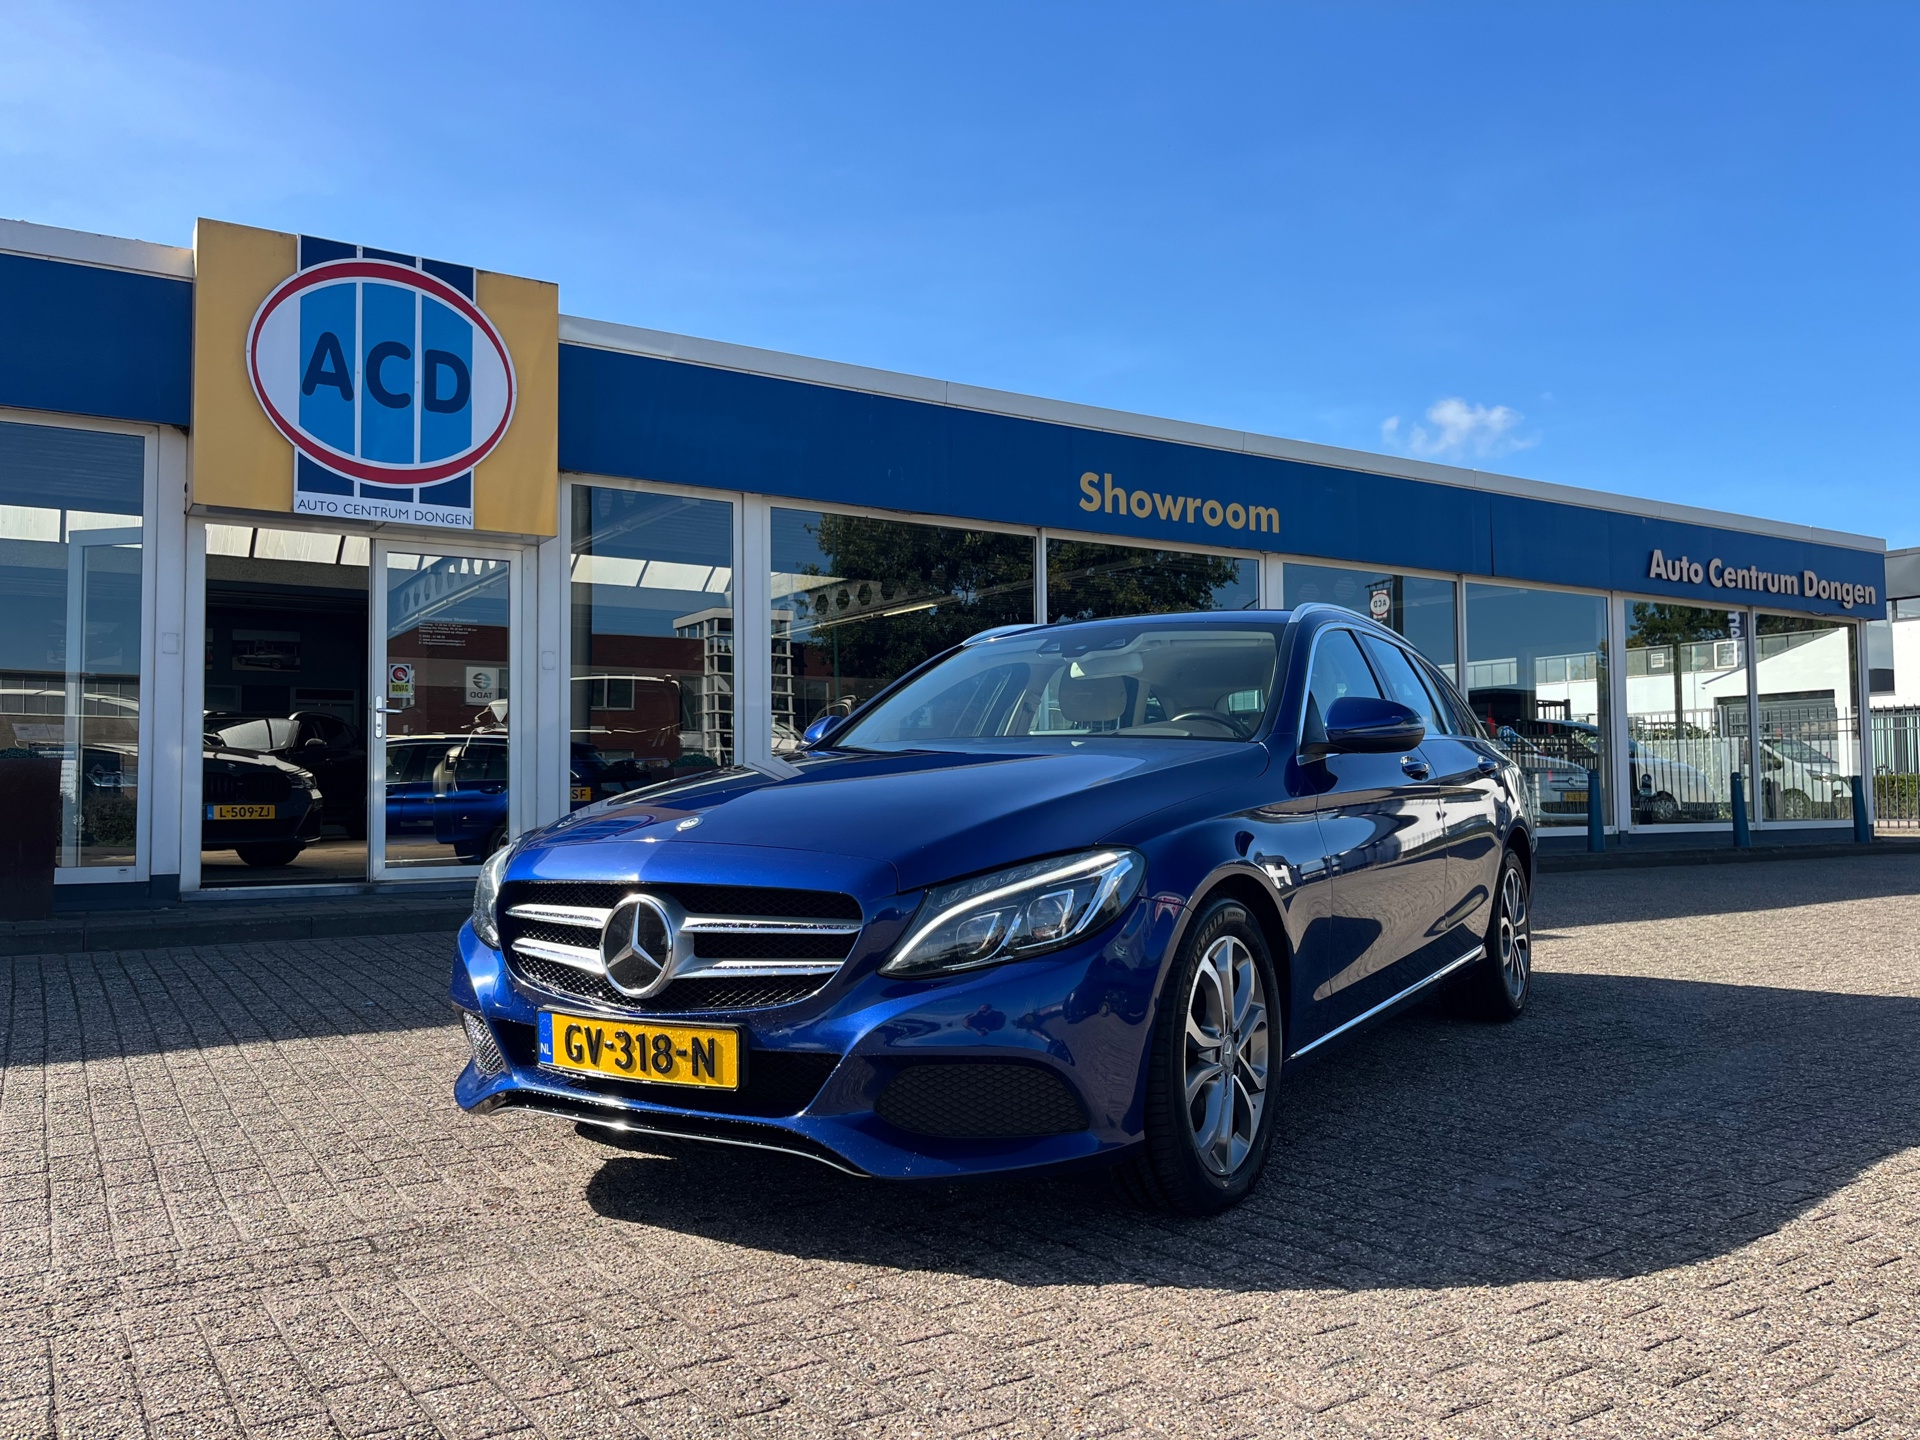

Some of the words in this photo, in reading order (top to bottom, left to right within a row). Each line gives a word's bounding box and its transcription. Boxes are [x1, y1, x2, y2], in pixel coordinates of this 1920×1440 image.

[301, 331, 471, 414] ACD
[297, 499, 338, 513] AUTO
[343, 502, 410, 520] CENTRUM
[414, 509, 472, 526] DONGEN
[1078, 471, 1280, 534] Showroom
[1649, 549, 1704, 584] Auto
[1708, 558, 1799, 595] Centrum
[1803, 569, 1877, 609] Dongen
[219, 806, 270, 818] L-509-ZJ
[1189, 912, 1224, 980] MICHELIN
[540, 1042, 552, 1055] NL
[564, 1022, 716, 1078] GV-318-N
